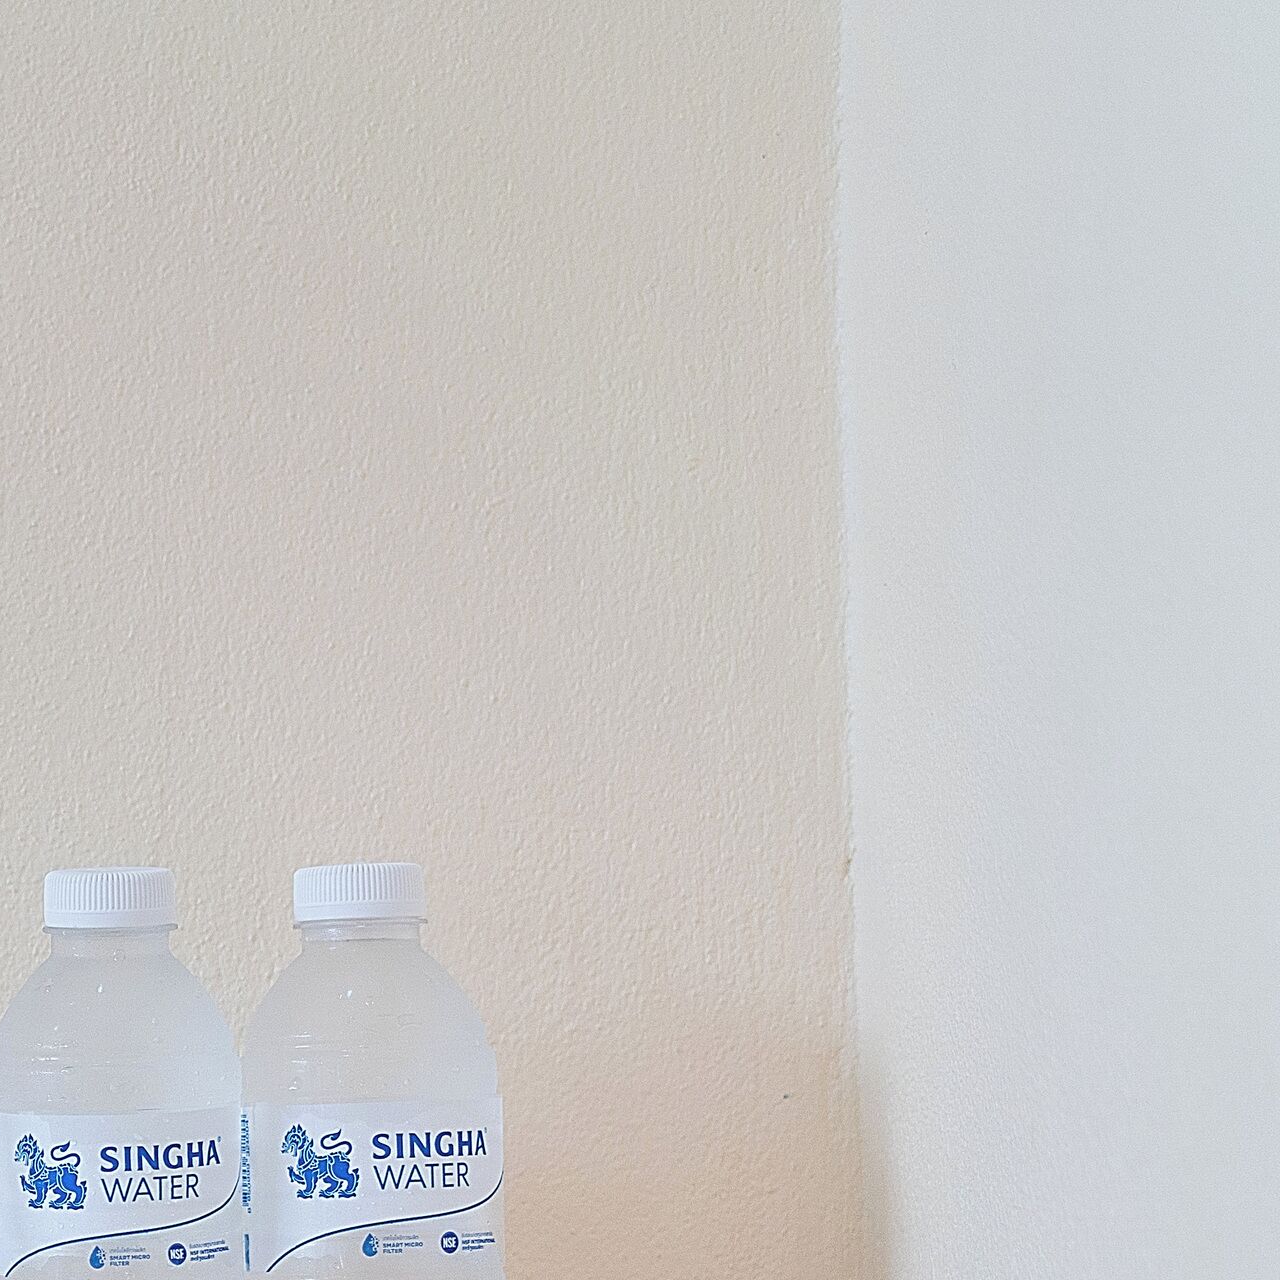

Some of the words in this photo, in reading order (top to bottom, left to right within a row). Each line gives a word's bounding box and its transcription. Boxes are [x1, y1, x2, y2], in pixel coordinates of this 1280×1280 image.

[100, 1139, 221, 1173] SINGHA
[372, 1130, 487, 1160] SINGHA
[100, 1173, 199, 1203] WATER
[373, 1162, 469, 1190] WATER
